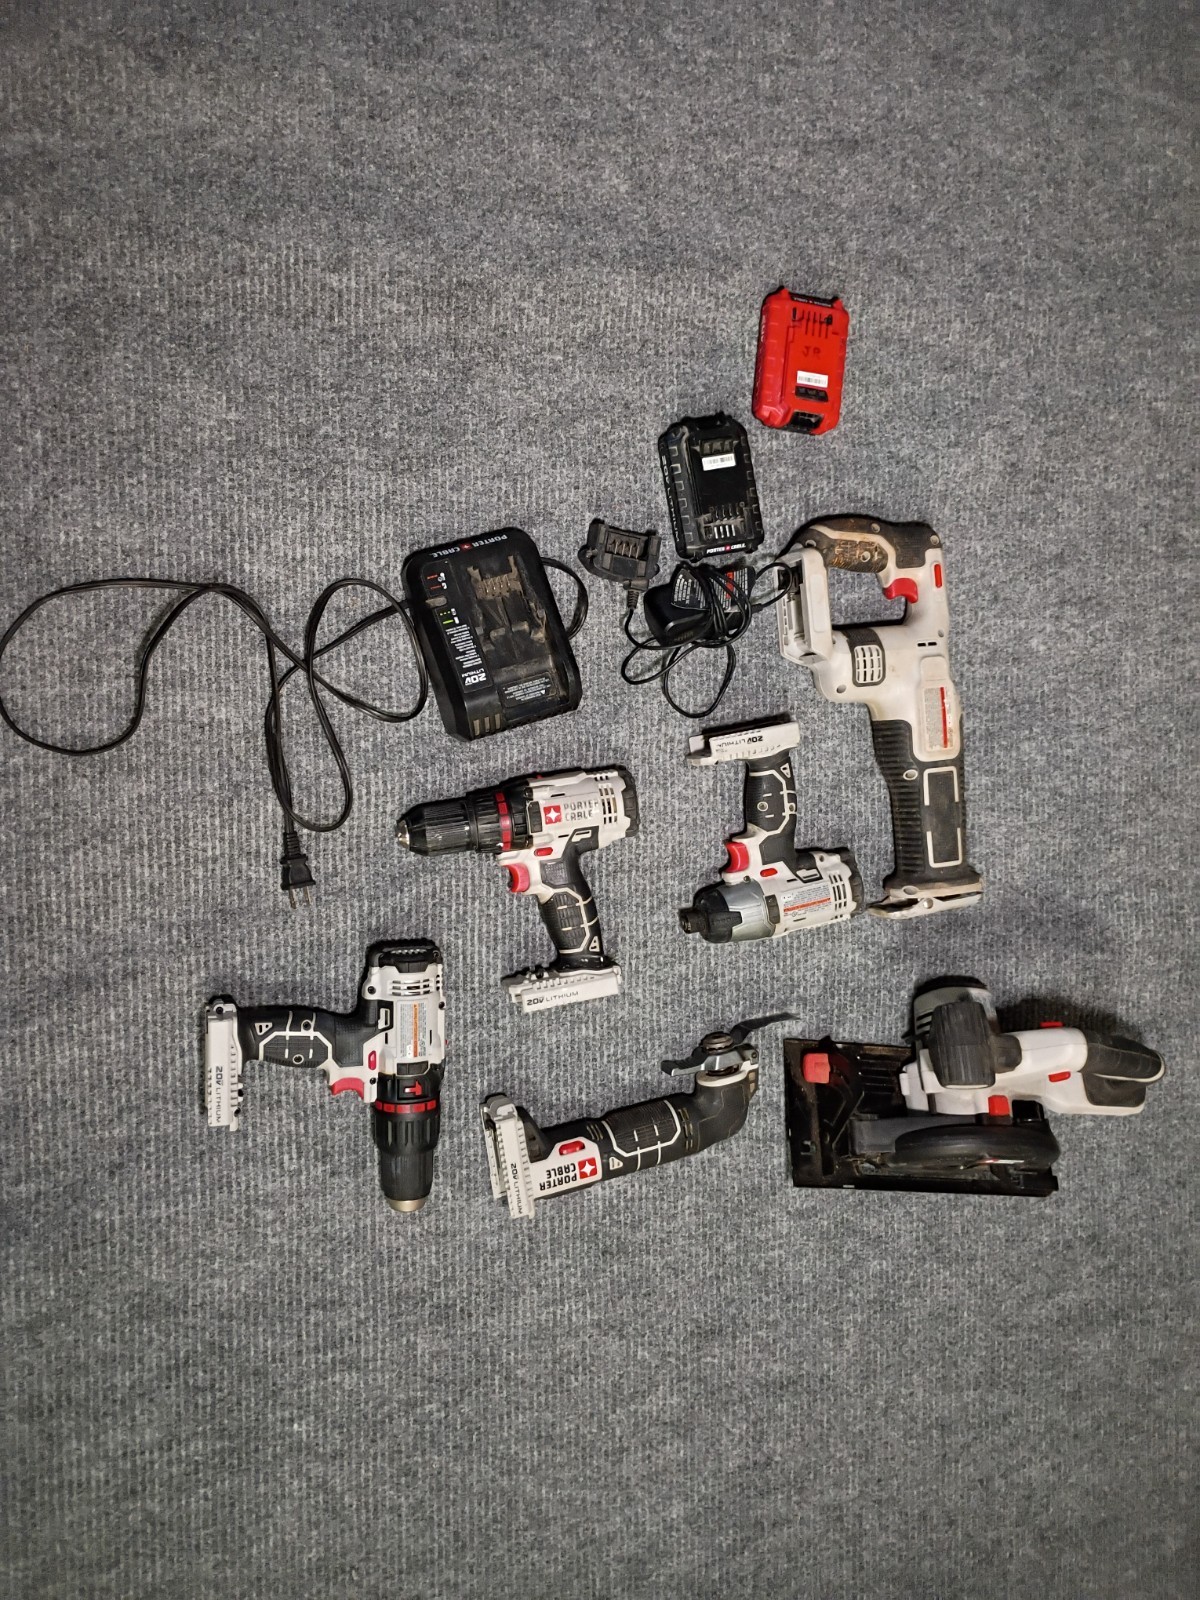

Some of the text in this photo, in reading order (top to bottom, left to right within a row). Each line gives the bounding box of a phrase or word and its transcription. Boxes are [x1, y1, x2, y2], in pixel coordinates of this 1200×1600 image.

[432, 534, 508, 559] PORTER CABLE
[461, 668, 485, 679] LITHIUM
[563, 799, 599, 811] PORTER
[565, 809, 593, 822] CABLE
[545, 991, 579, 1002] LITHIUM
[546, 1162, 576, 1179] CABLE
[539, 1173, 577, 1191] PORTER
[513, 1180, 523, 1215] LITHIUM
